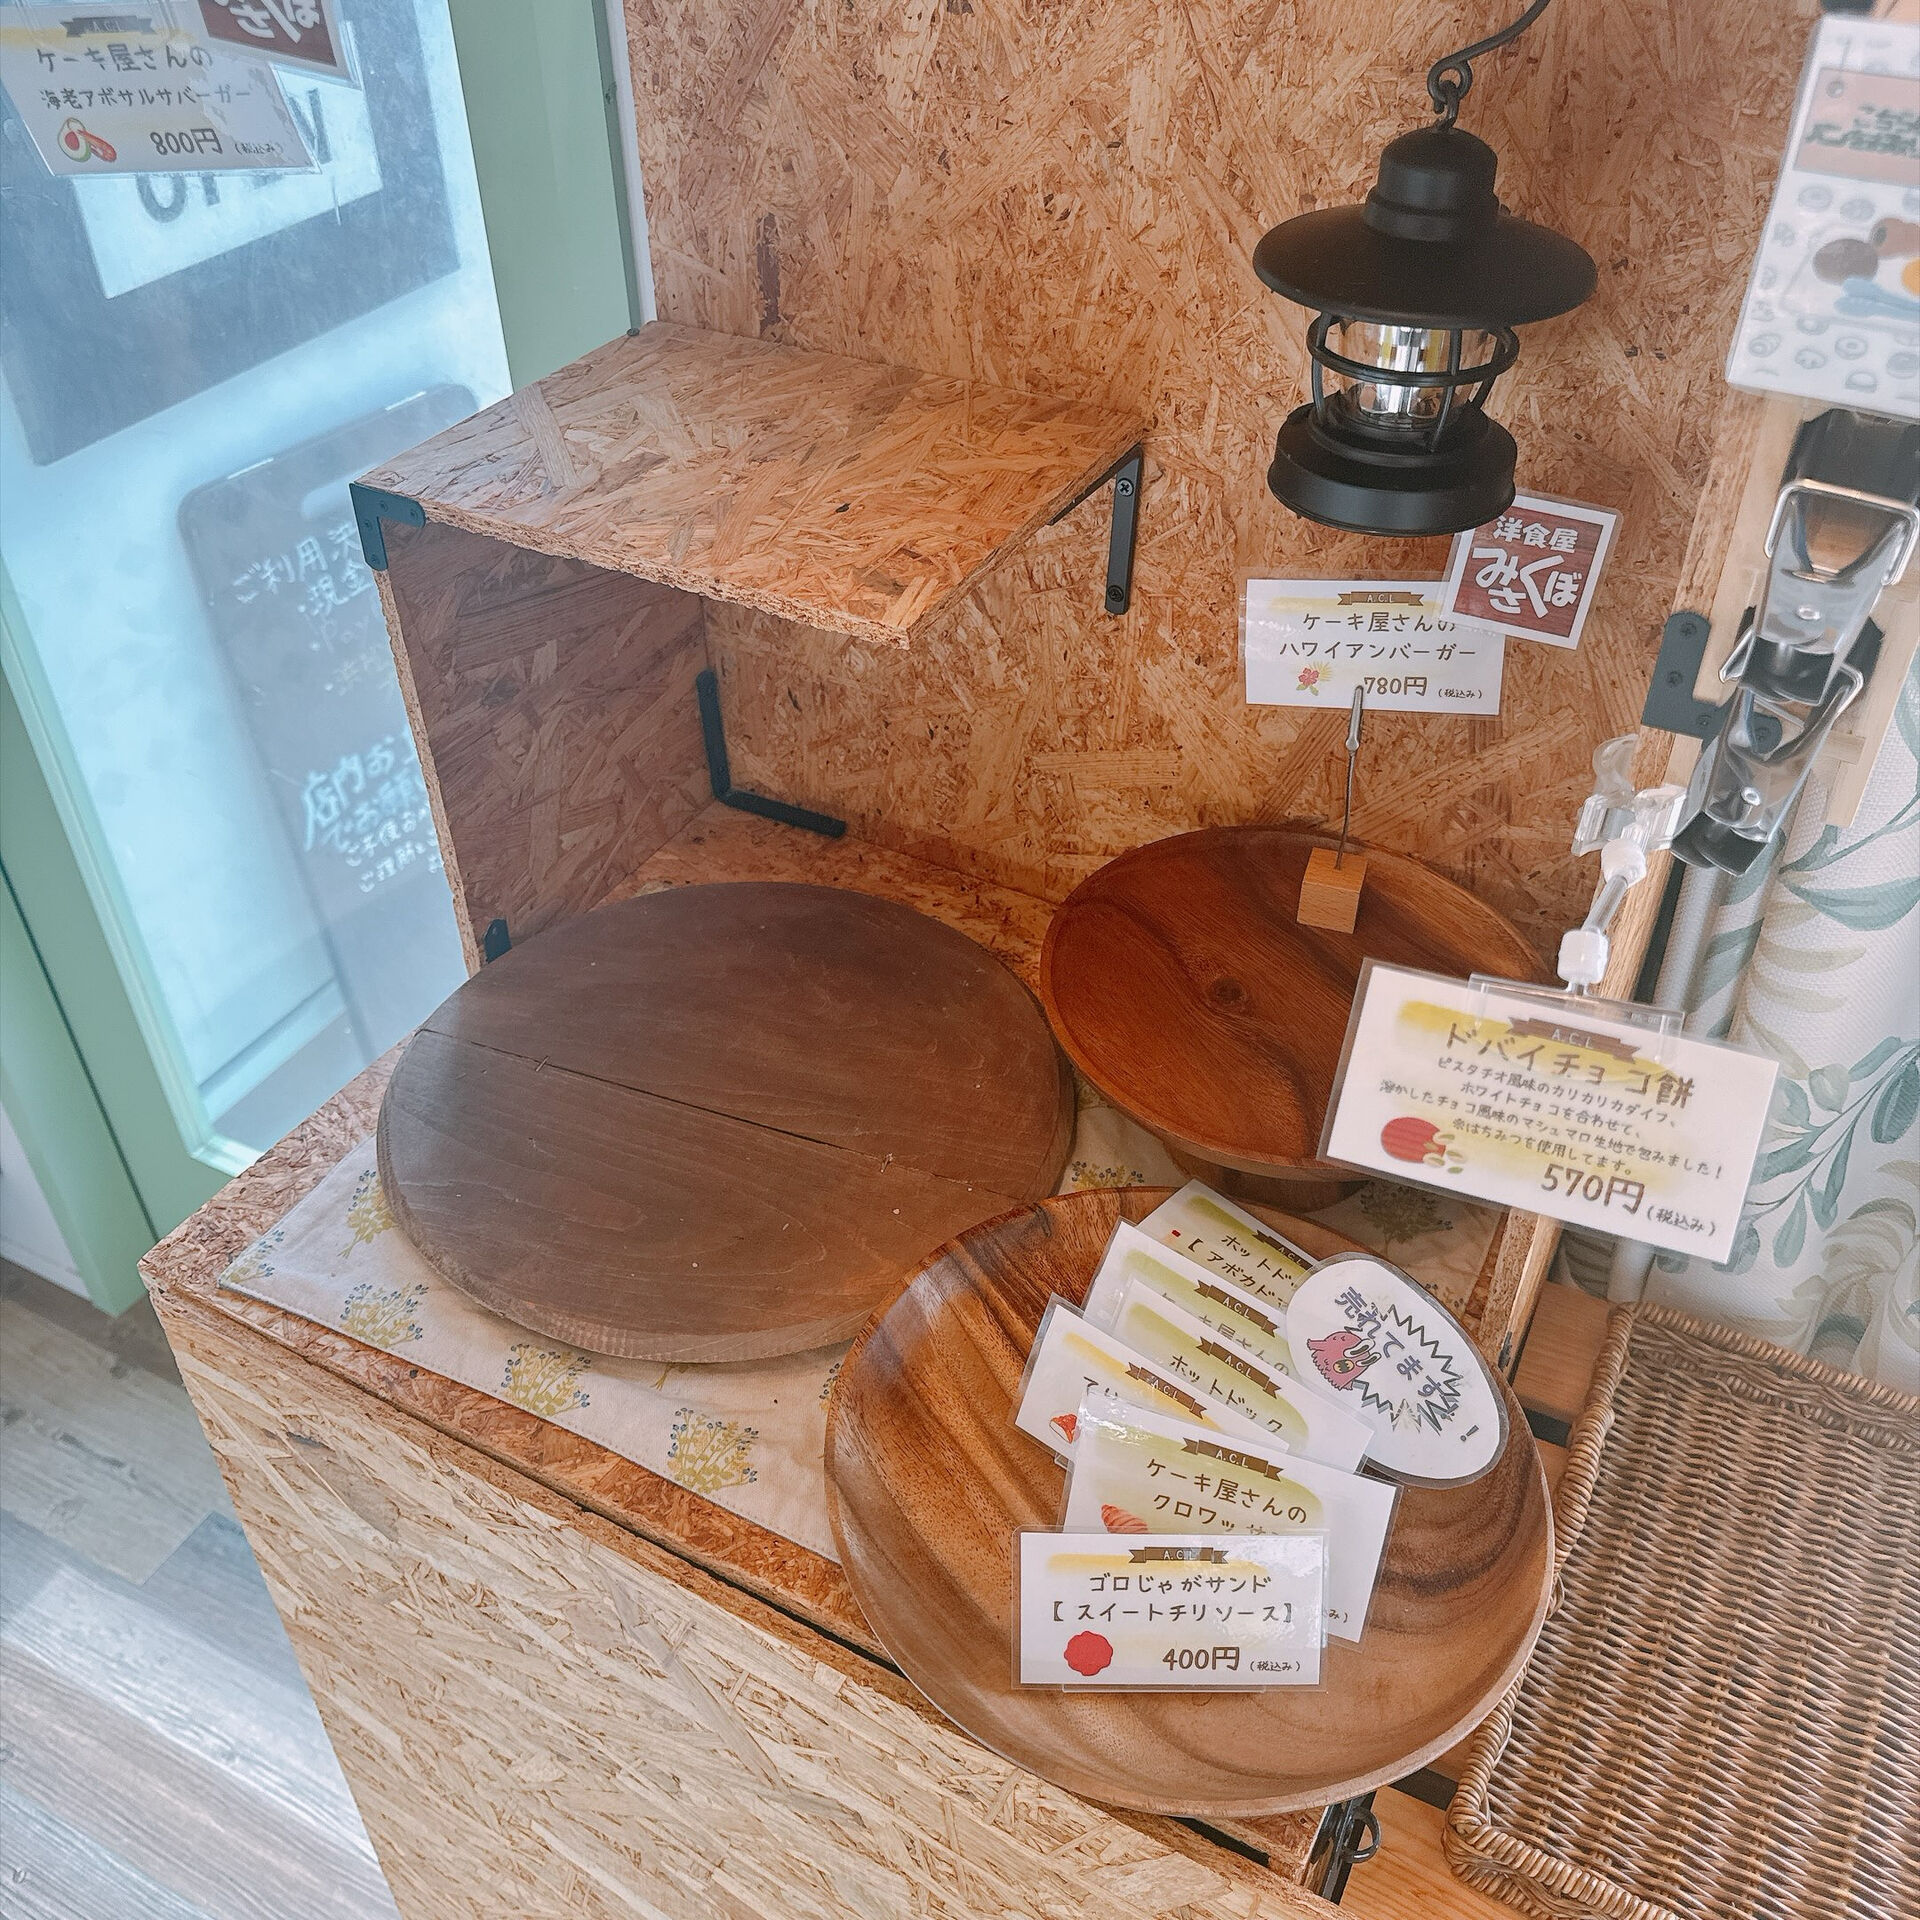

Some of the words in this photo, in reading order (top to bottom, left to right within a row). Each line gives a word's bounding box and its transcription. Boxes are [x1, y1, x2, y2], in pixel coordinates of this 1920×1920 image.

[37, 43, 213, 72] ケーキ屋さんの
[40, 84, 250, 111] 海老アボサルサバーガー
[149, 128, 223, 156] 800円
[1492, 516, 1580, 553] 洋食屋
[1472, 547, 1583, 618] みさくぼ
[1302, 611, 1457, 633] ケーキ屋さんの
[1279, 641, 1476, 661] ハワイアンバーガー
[1363, 676, 1428, 697] 780円
[1445, 1022, 1696, 1110] ドバイチョコ餅
[1460, 1081, 1642, 1138] ホワイトチョコを合わせて、
[1541, 1163, 1645, 1215] 570円
[1222, 1296, 1251, 1319] A.C.L
[1224, 1355, 1252, 1378] A.C.L
[1215, 1449, 1249, 1468] A.C.L
[1146, 1458, 1307, 1524] ケーキ屋さんの
[1089, 1573, 1272, 1594] ゴロじゃがサンド
[1053, 1601, 1292, 1623] 【スイートチリソース】
[1162, 1646, 1240, 1672] 400円
